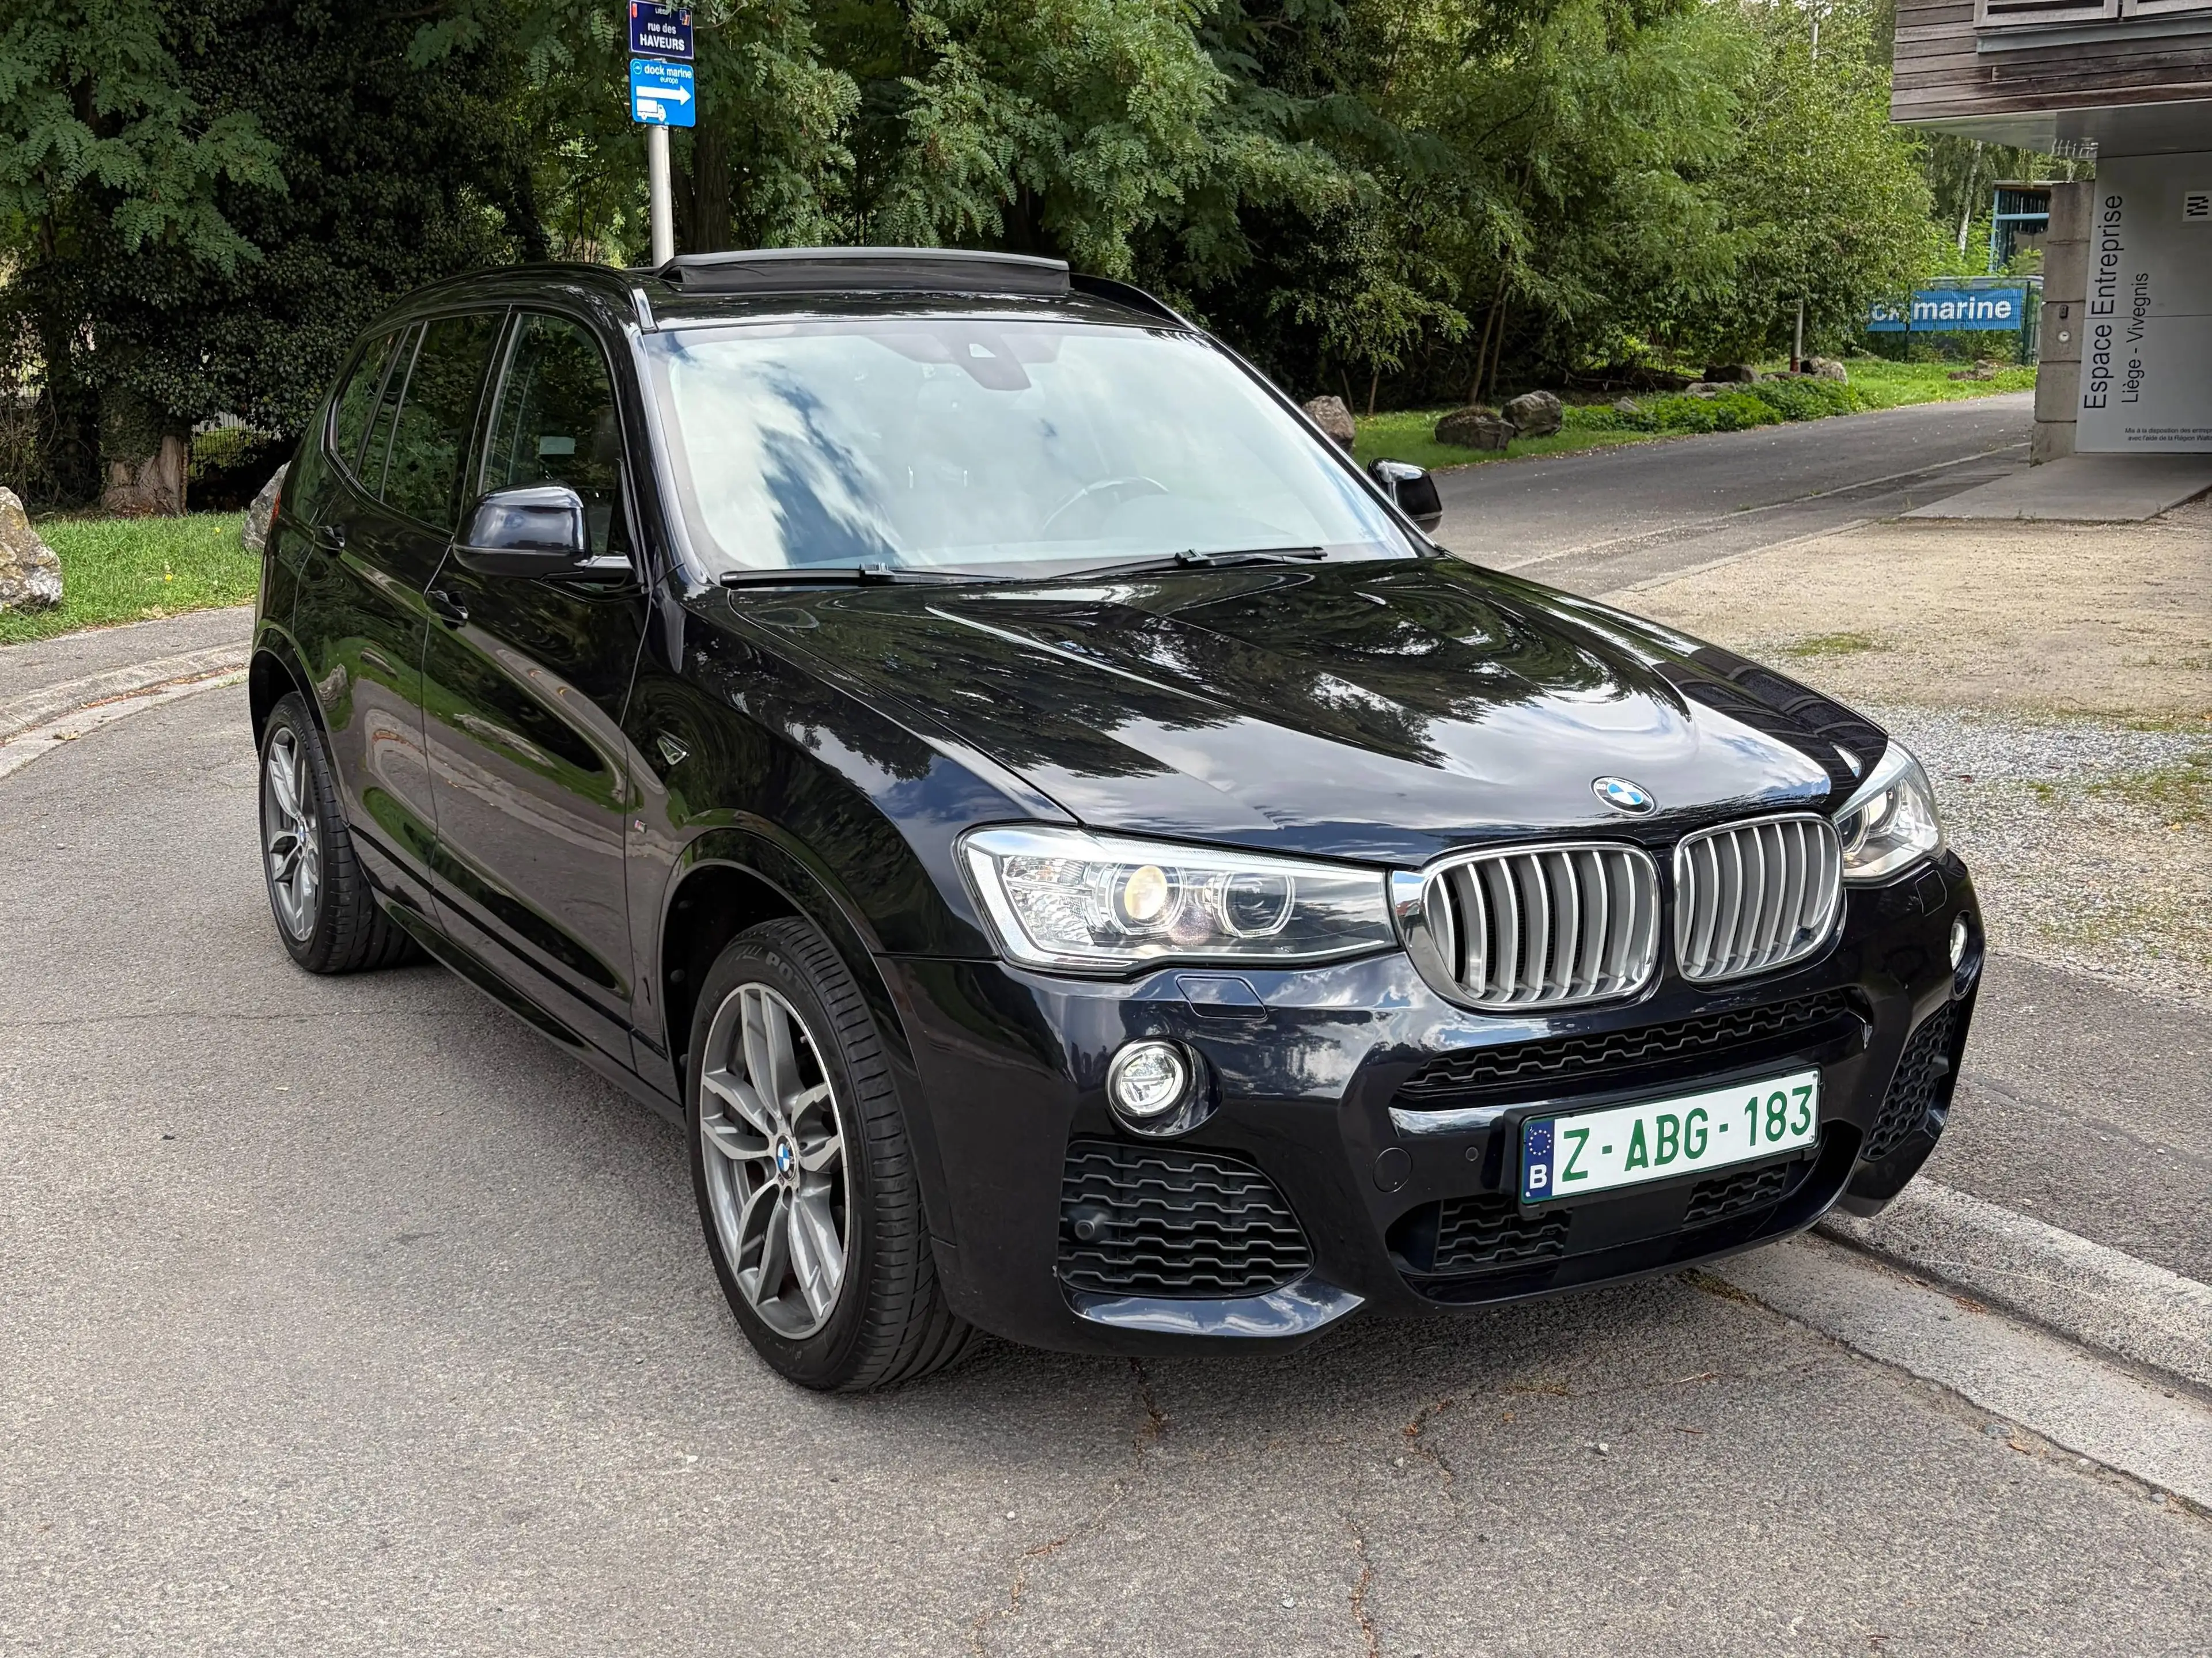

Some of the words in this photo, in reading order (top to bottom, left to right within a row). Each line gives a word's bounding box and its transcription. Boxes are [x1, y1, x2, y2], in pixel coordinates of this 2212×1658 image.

[647, 22, 661, 32] rue
[662, 23, 676, 35] des
[639, 33, 685, 51] HAVEURS
[644, 64, 664, 75] dock
[666, 67, 692, 79] marine
[2091, 195, 2124, 315] Entreprise
[1913, 296, 2012, 320] marine
[2126, 272, 2151, 343] Vivegnis
[2084, 324, 2114, 409] Espace
[2121, 359, 2145, 403] Liège
[1529, 1164, 1547, 1190] B
